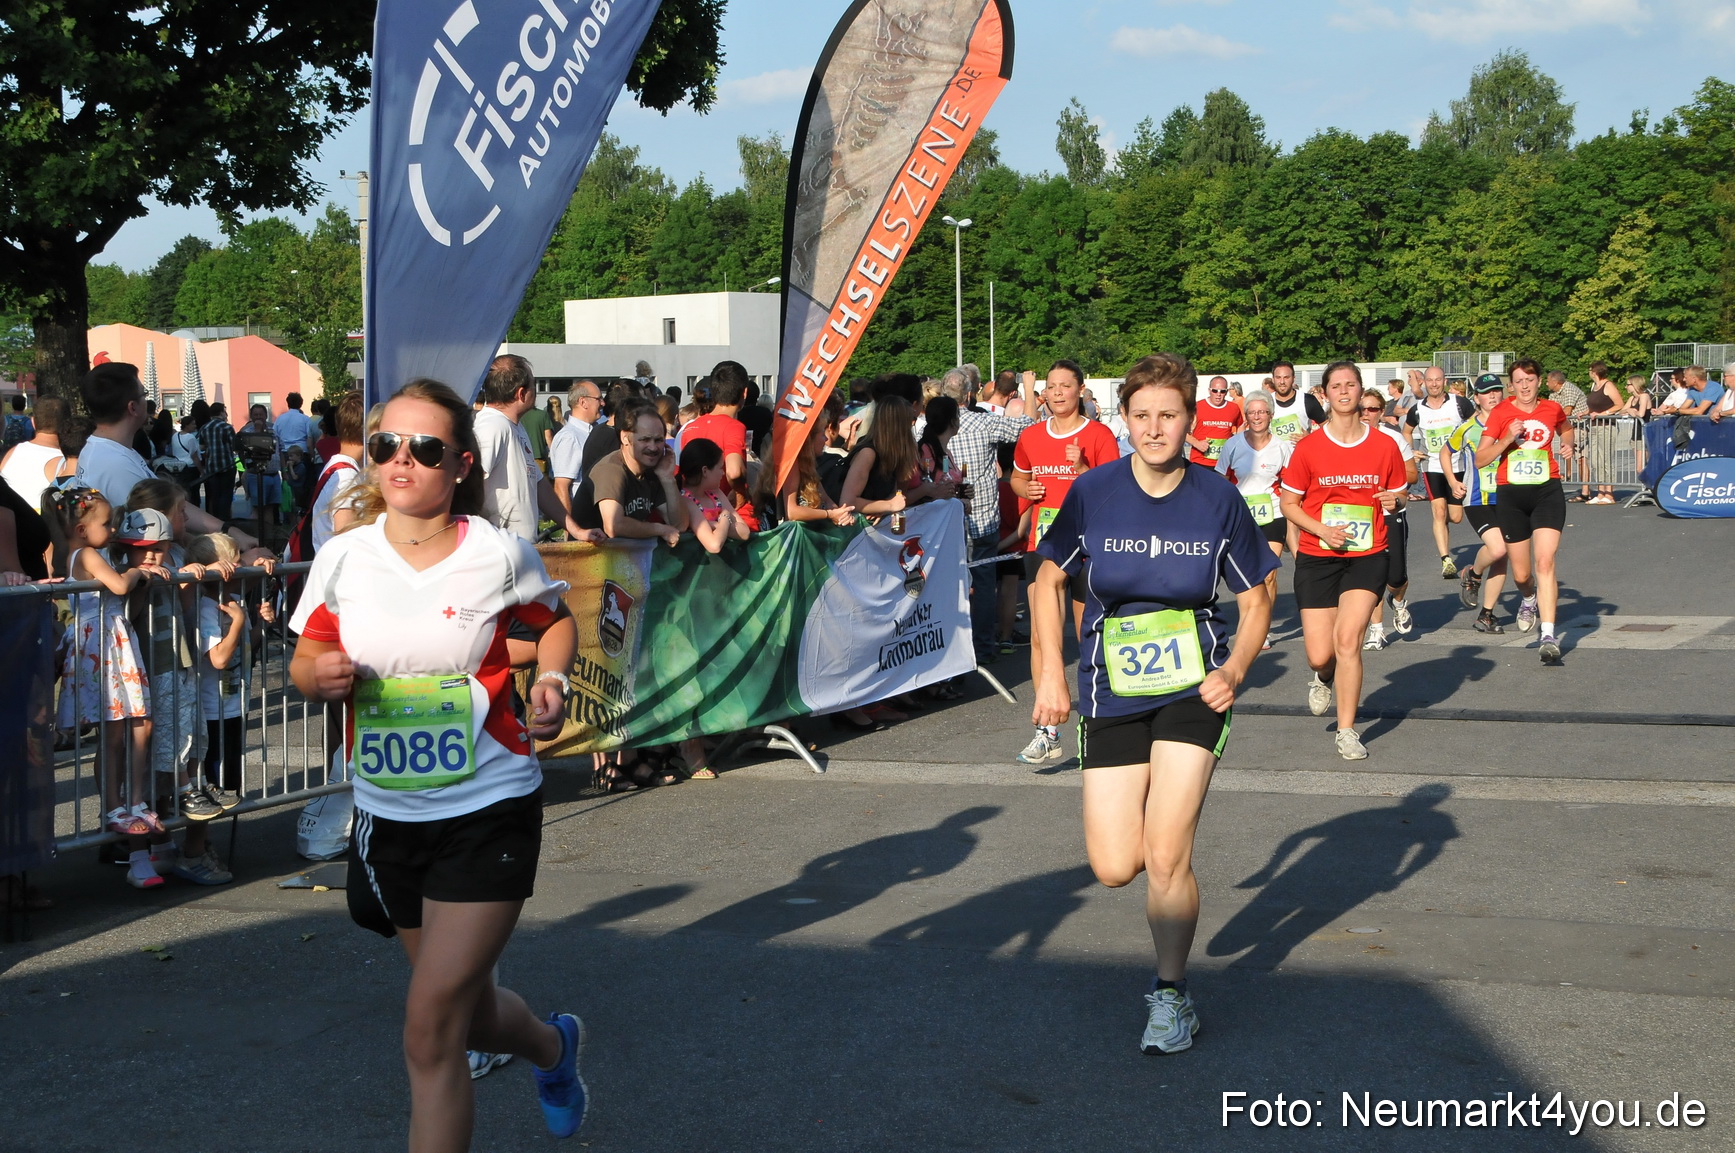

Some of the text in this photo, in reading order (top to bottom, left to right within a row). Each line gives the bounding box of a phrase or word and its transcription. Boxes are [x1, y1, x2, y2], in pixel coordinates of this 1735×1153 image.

[518, 0, 616, 189] AUTOMOB
[1275, 423, 1296, 436] 538
[1513, 461, 1543, 475] 455
[1318, 474, 1373, 486] NEUMARKT
[1104, 538, 1210, 556] EURO POLES
[1118, 638, 1182, 676] 321
[361, 728, 467, 775] 5086
